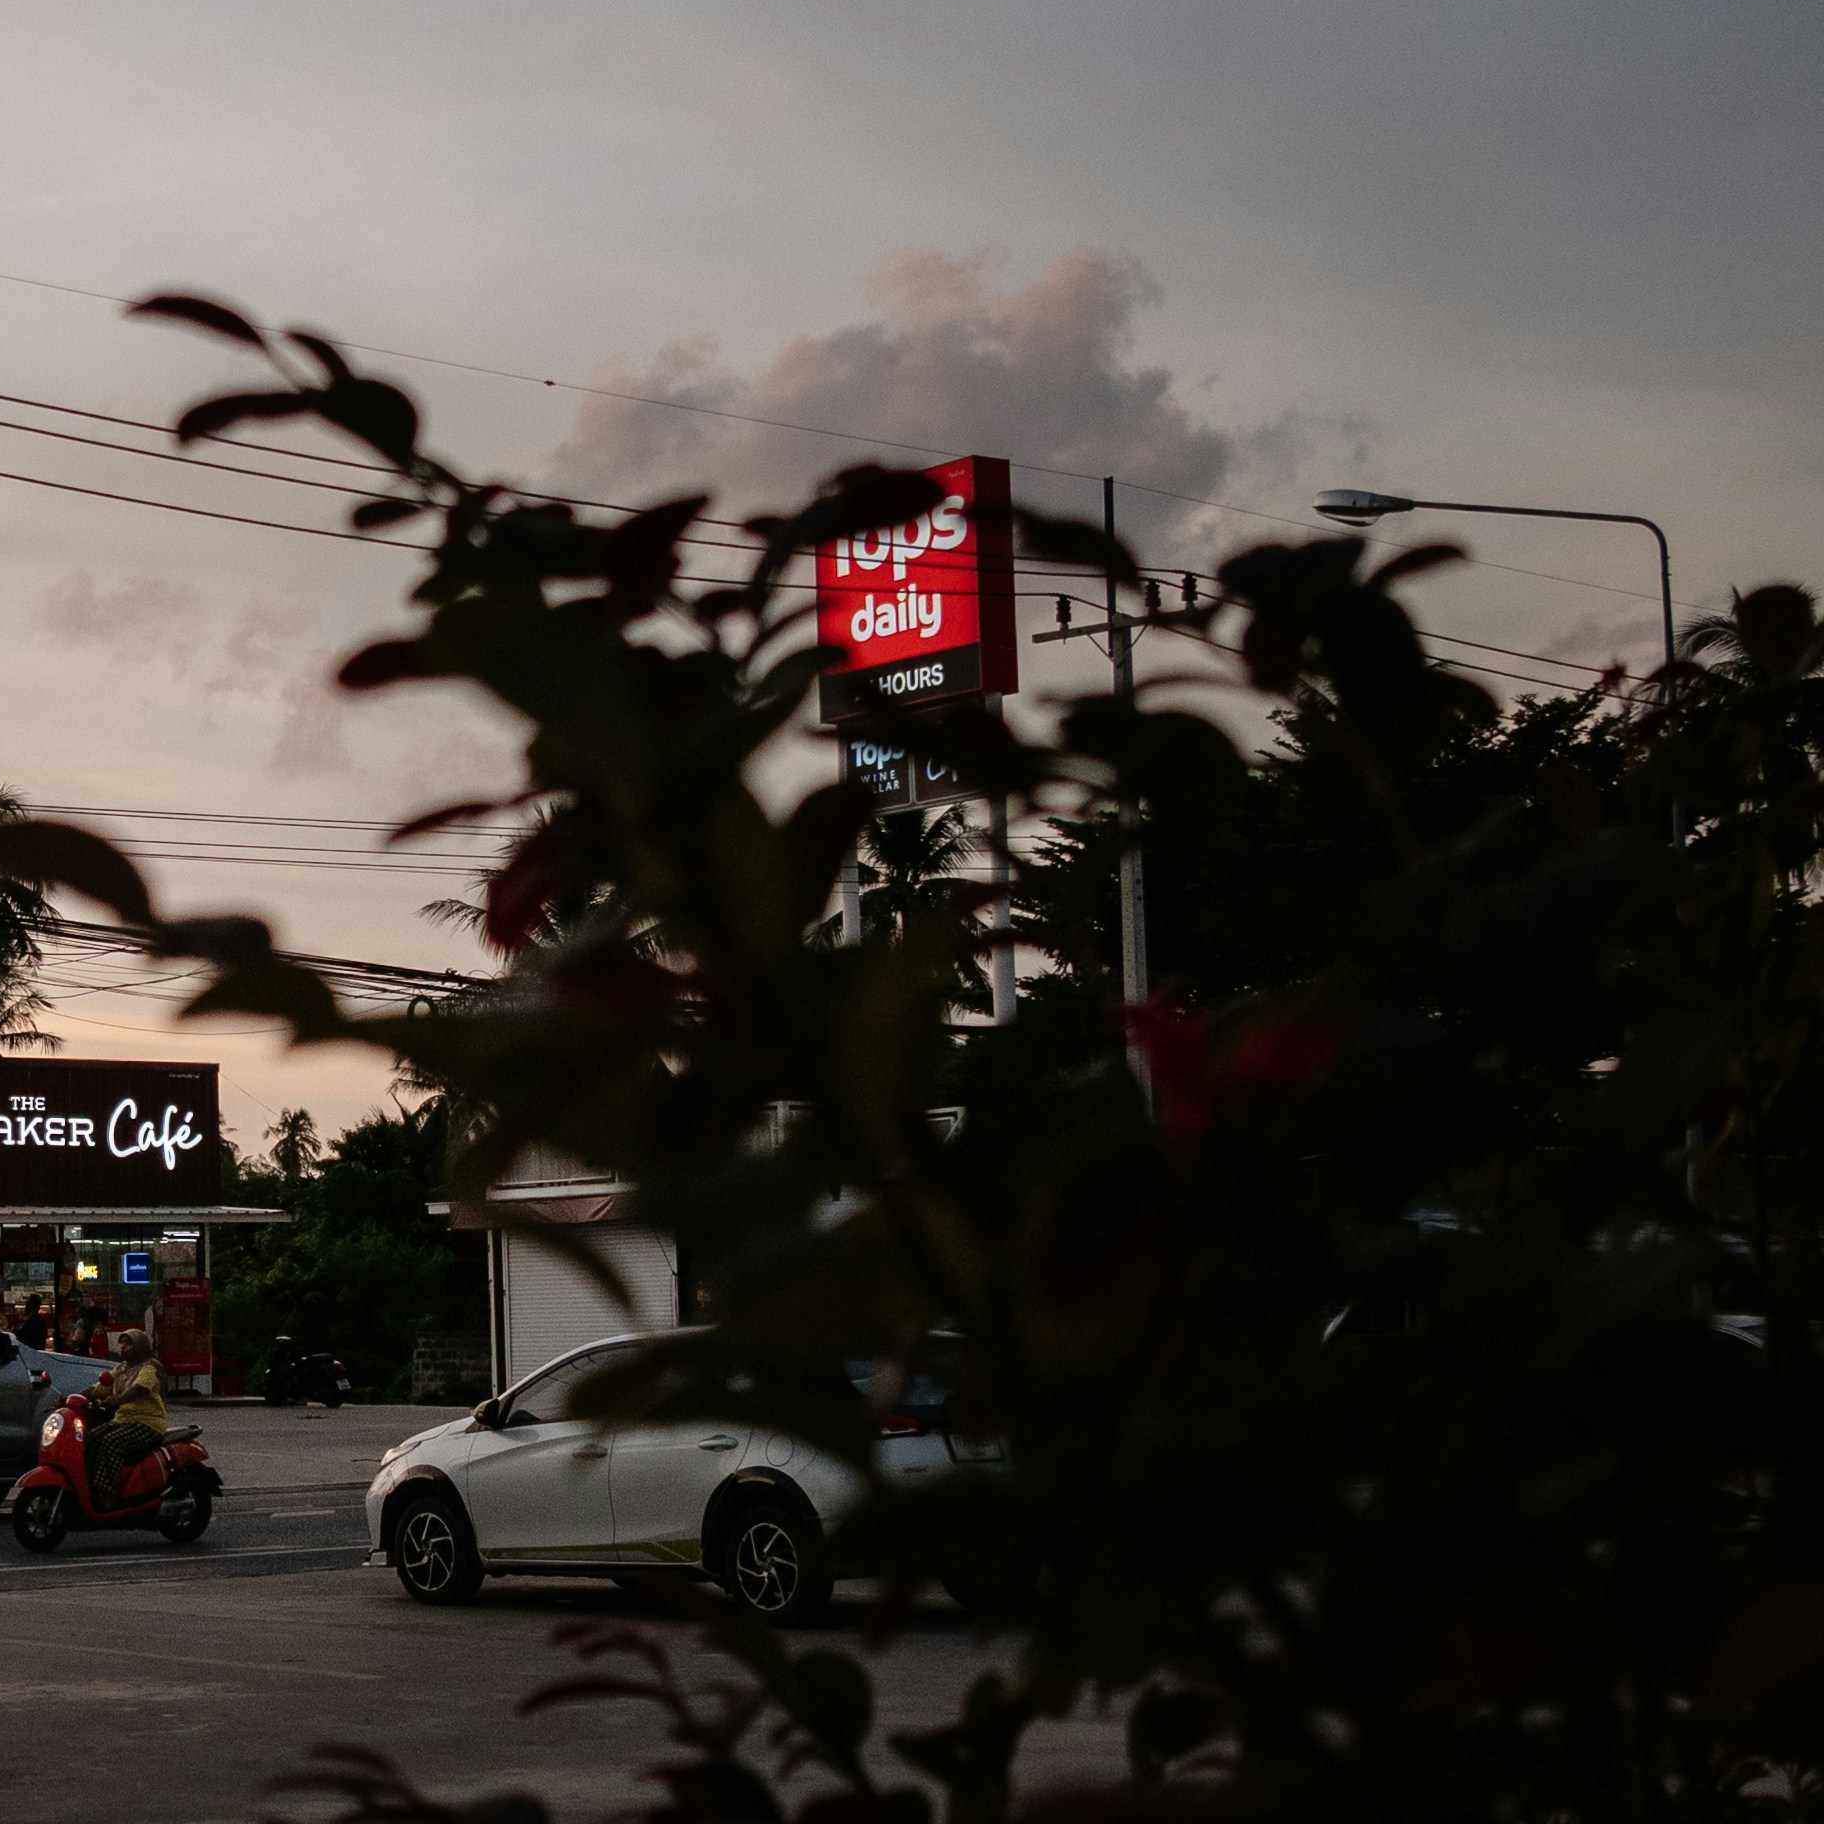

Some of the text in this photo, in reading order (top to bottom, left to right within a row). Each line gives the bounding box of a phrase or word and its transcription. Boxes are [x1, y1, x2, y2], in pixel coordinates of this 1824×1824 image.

[850, 582, 942, 643] daily
[878, 662, 945, 696] HOURS
[9, 1095, 46, 1111] THE
[106, 1097, 204, 1171] Café
